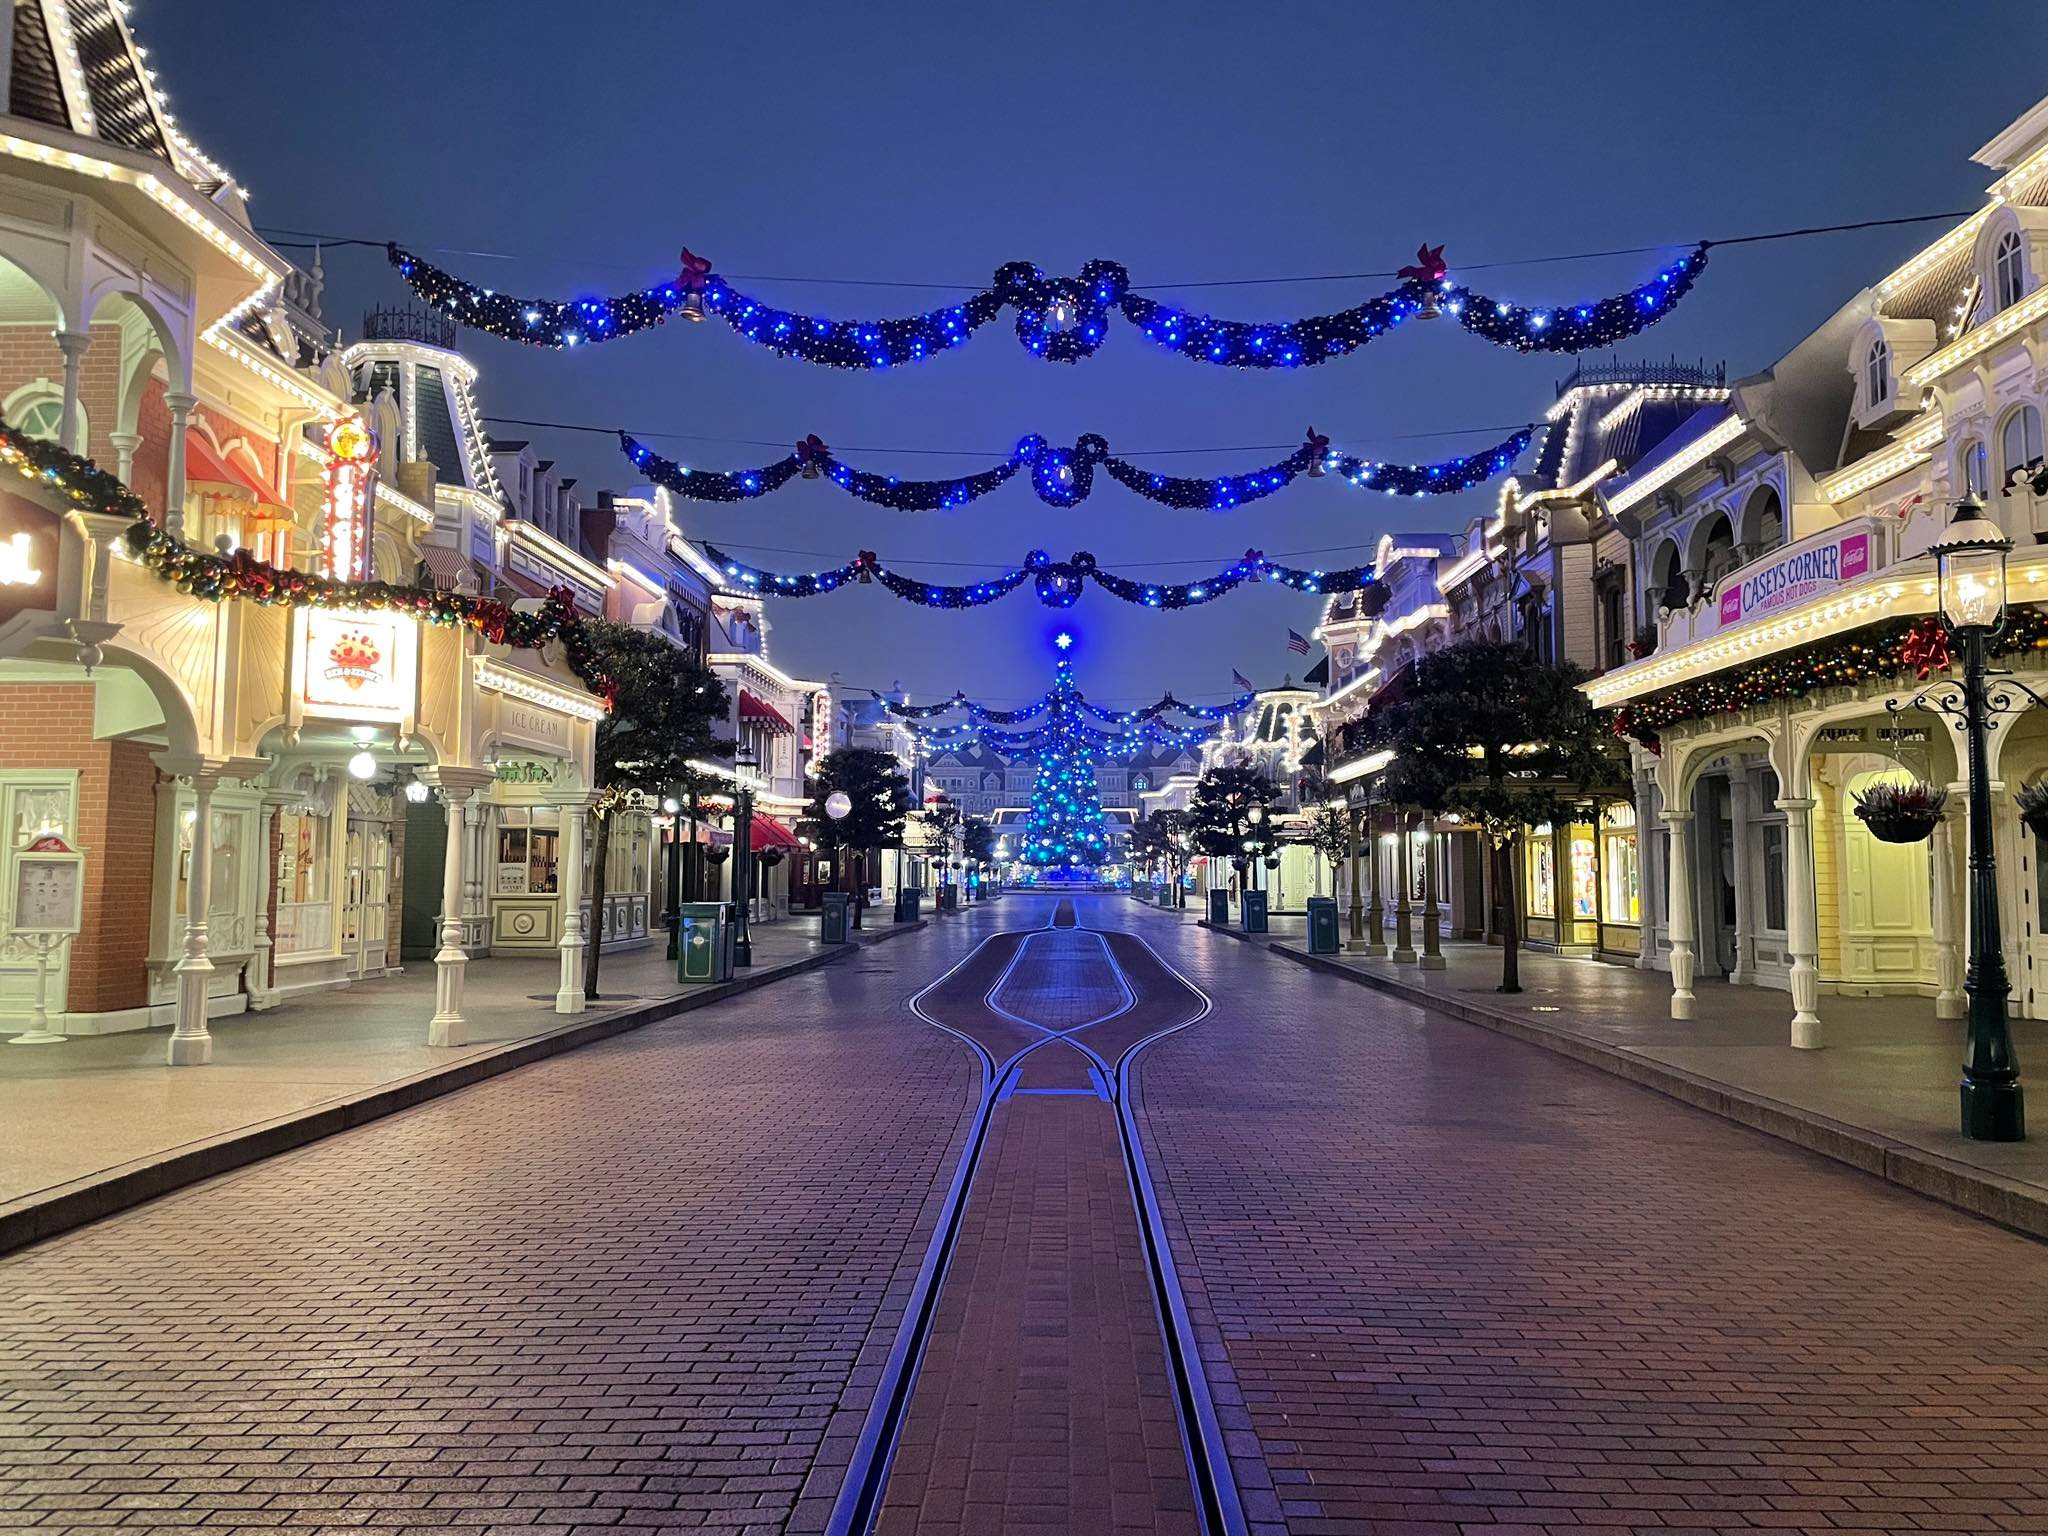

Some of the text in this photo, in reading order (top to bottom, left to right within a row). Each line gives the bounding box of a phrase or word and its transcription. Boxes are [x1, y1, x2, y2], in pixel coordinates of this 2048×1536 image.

[1788, 545, 1839, 584] CORNER
[1760, 580, 1817, 611] FAMOUS HOT DOGS
[511, 711, 559, 736] ICE CREAM
